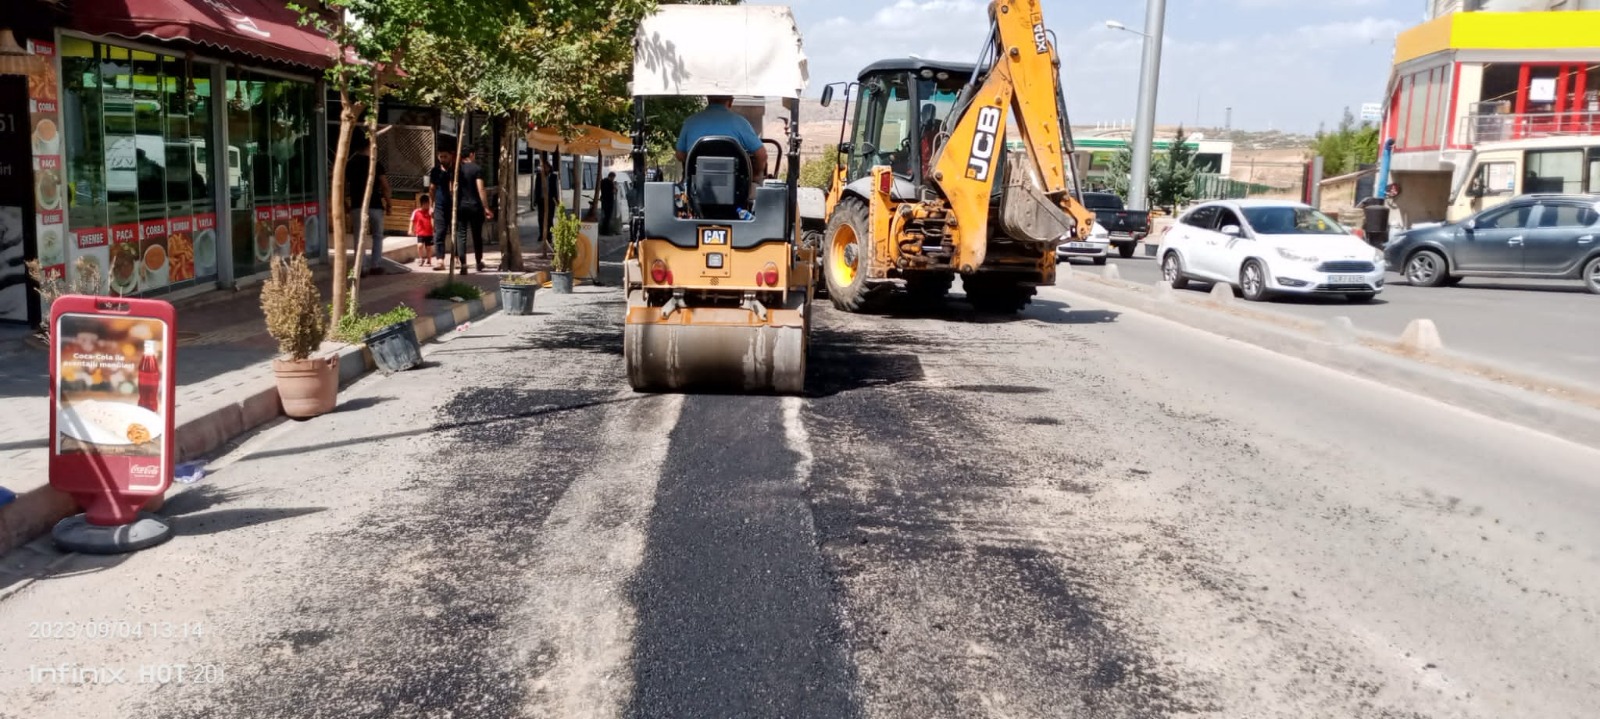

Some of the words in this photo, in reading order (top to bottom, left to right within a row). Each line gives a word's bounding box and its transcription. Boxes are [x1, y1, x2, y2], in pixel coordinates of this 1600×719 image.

[969, 106, 1000, 181] JCB
[116, 229, 134, 242] PAÇA
[703, 229, 726, 245] CAT
